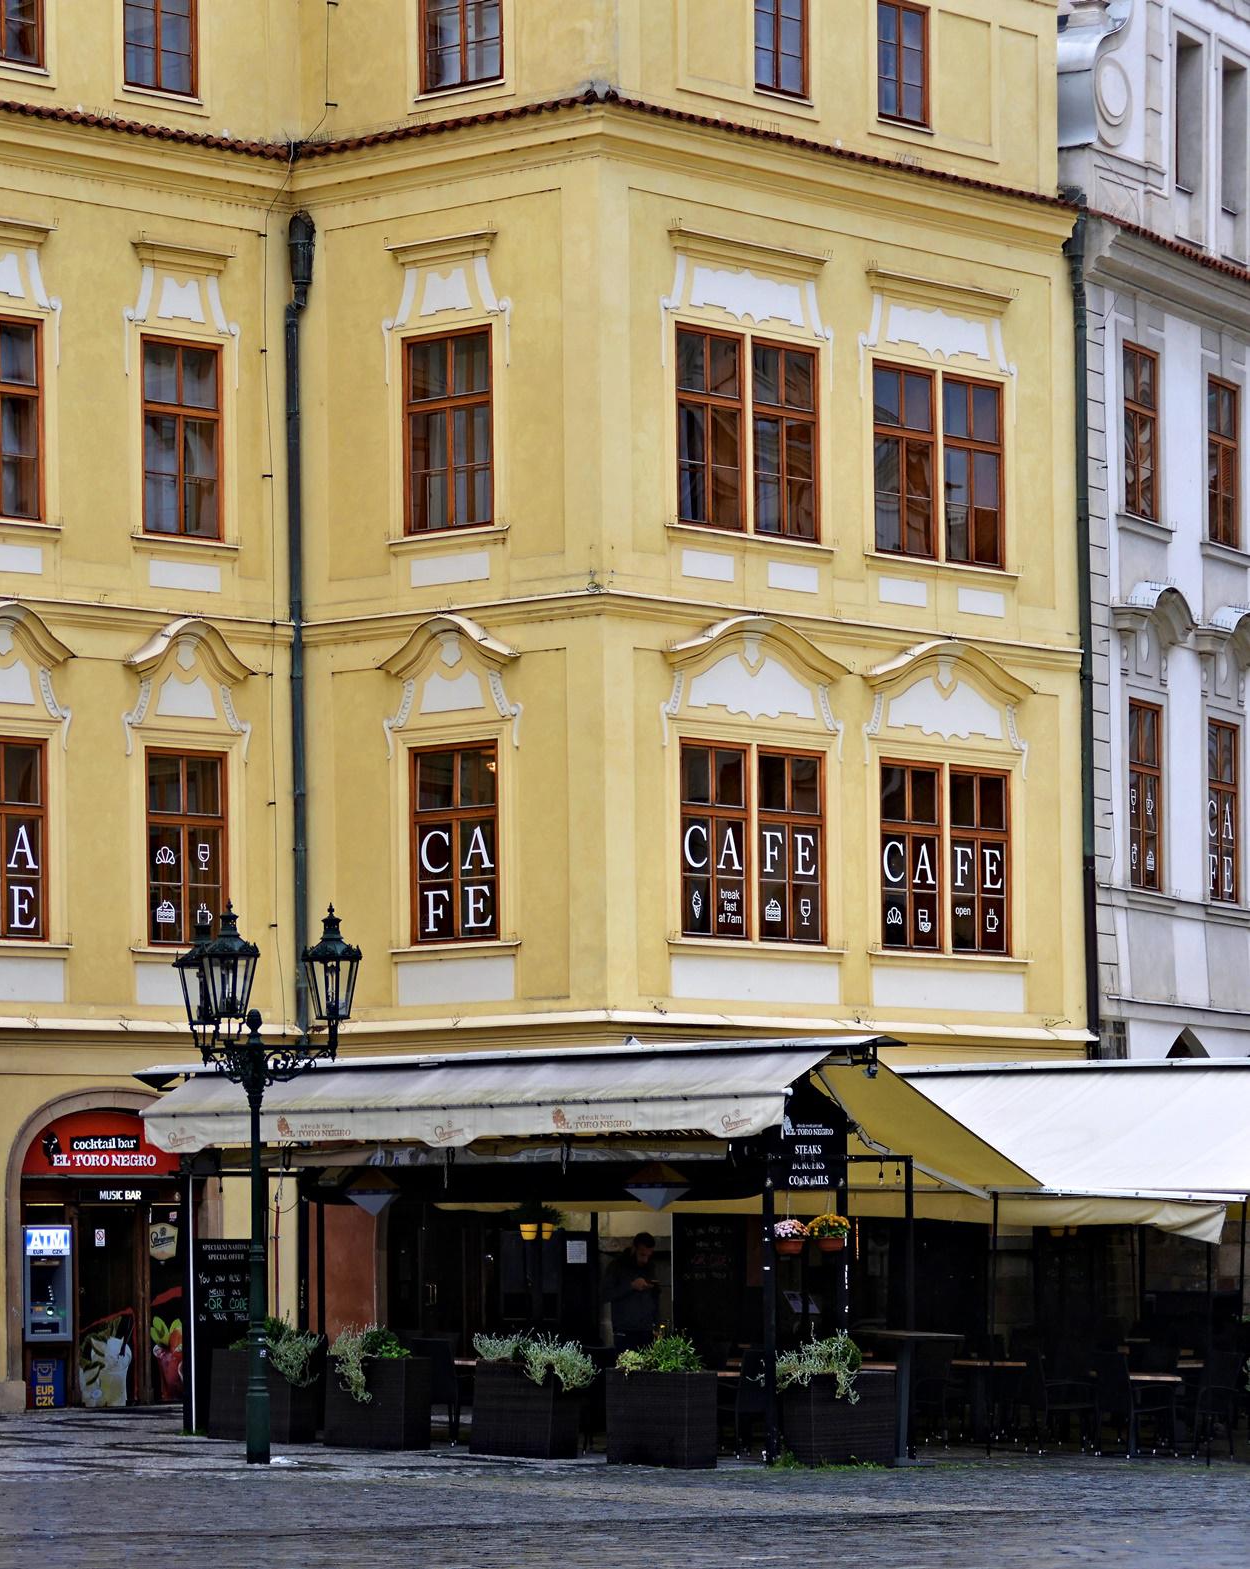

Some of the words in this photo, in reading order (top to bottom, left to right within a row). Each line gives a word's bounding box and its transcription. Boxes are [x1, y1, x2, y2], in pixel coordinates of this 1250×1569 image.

[420, 825, 494, 874] CA
[683, 824, 817, 876] CAFE
[882, 840, 1003, 890] CAFE
[720, 888, 740, 900] break
[424, 884, 492, 933] FE
[723, 901, 737, 912] fast
[955, 906, 971, 917] open
[718, 913, 726, 923] at
[727, 913, 742, 924] 7am
[73, 1138, 116, 1150] cocktail
[118, 1138, 137, 1149] bar
[794, 1145, 822, 1155] STEAKS
[53, 1154, 71, 1167] EL
[72, 1154, 109, 1167] TORO
[111, 1154, 156, 1167] NEGRO
[788, 1175, 829, 1186] COKAILS
[99, 1190, 123, 1200] MUSIC
[124, 1190, 142, 1200] BAR
[30, 1231, 66, 1248] ATM
[208, 1297, 223, 1310] QR
[35, 1385, 54, 1395] EUR
[35, 1396, 54, 1407] CZK
